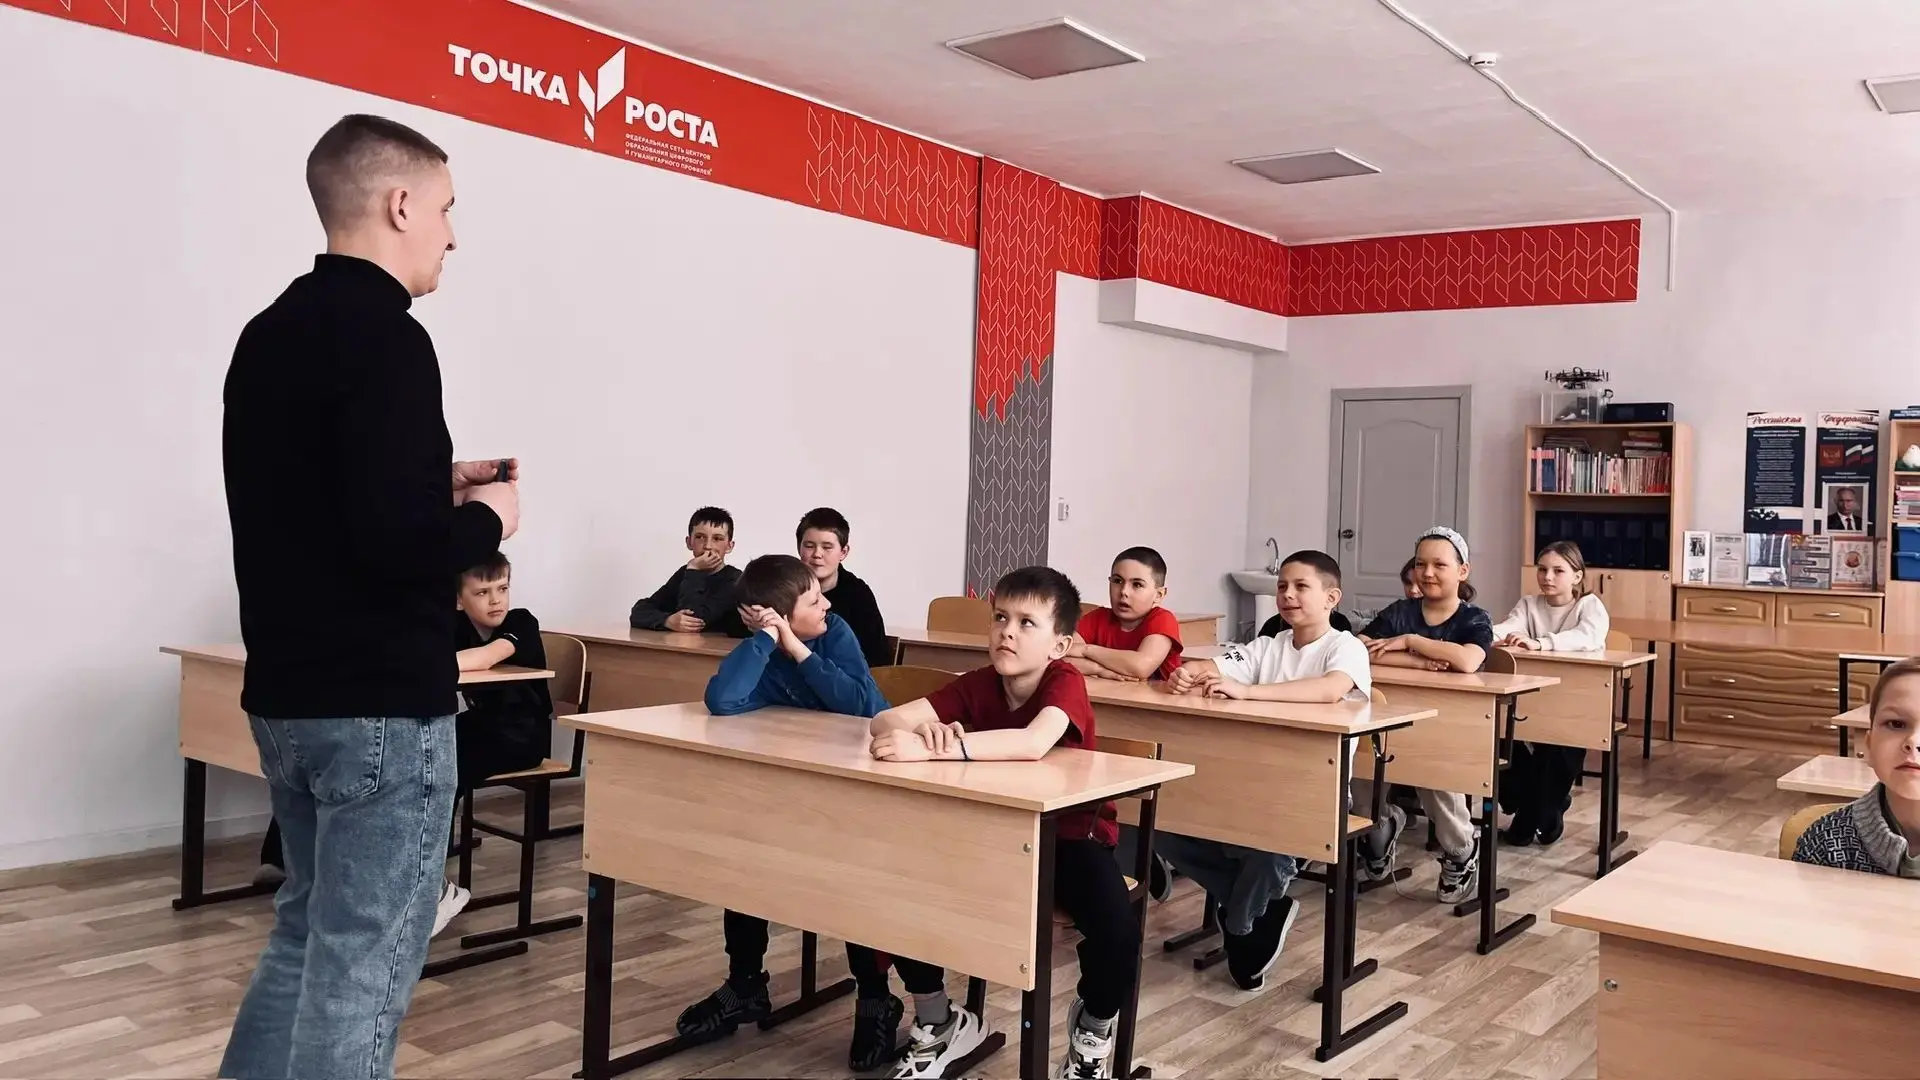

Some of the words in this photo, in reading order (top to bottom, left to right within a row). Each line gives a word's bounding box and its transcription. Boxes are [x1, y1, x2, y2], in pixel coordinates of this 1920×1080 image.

[447, 43, 570, 106] ТОЧКА
[625, 96, 719, 148] РОСТА
[625, 133, 669, 149] ФЕДЕРАЛЬНАЯ
[669, 144, 685, 154] СЕТЬ
[685, 149, 711, 160] ЦЕНТРОВ
[625, 141, 669, 157] ОБРАЗОВАНИЯ
[669, 152, 704, 166] ЦИФРОВОГО
[630, 150, 680, 168] ГУМАНИТАРНОГО
[680, 163, 712, 176] ПРОФИЛЕЙ
